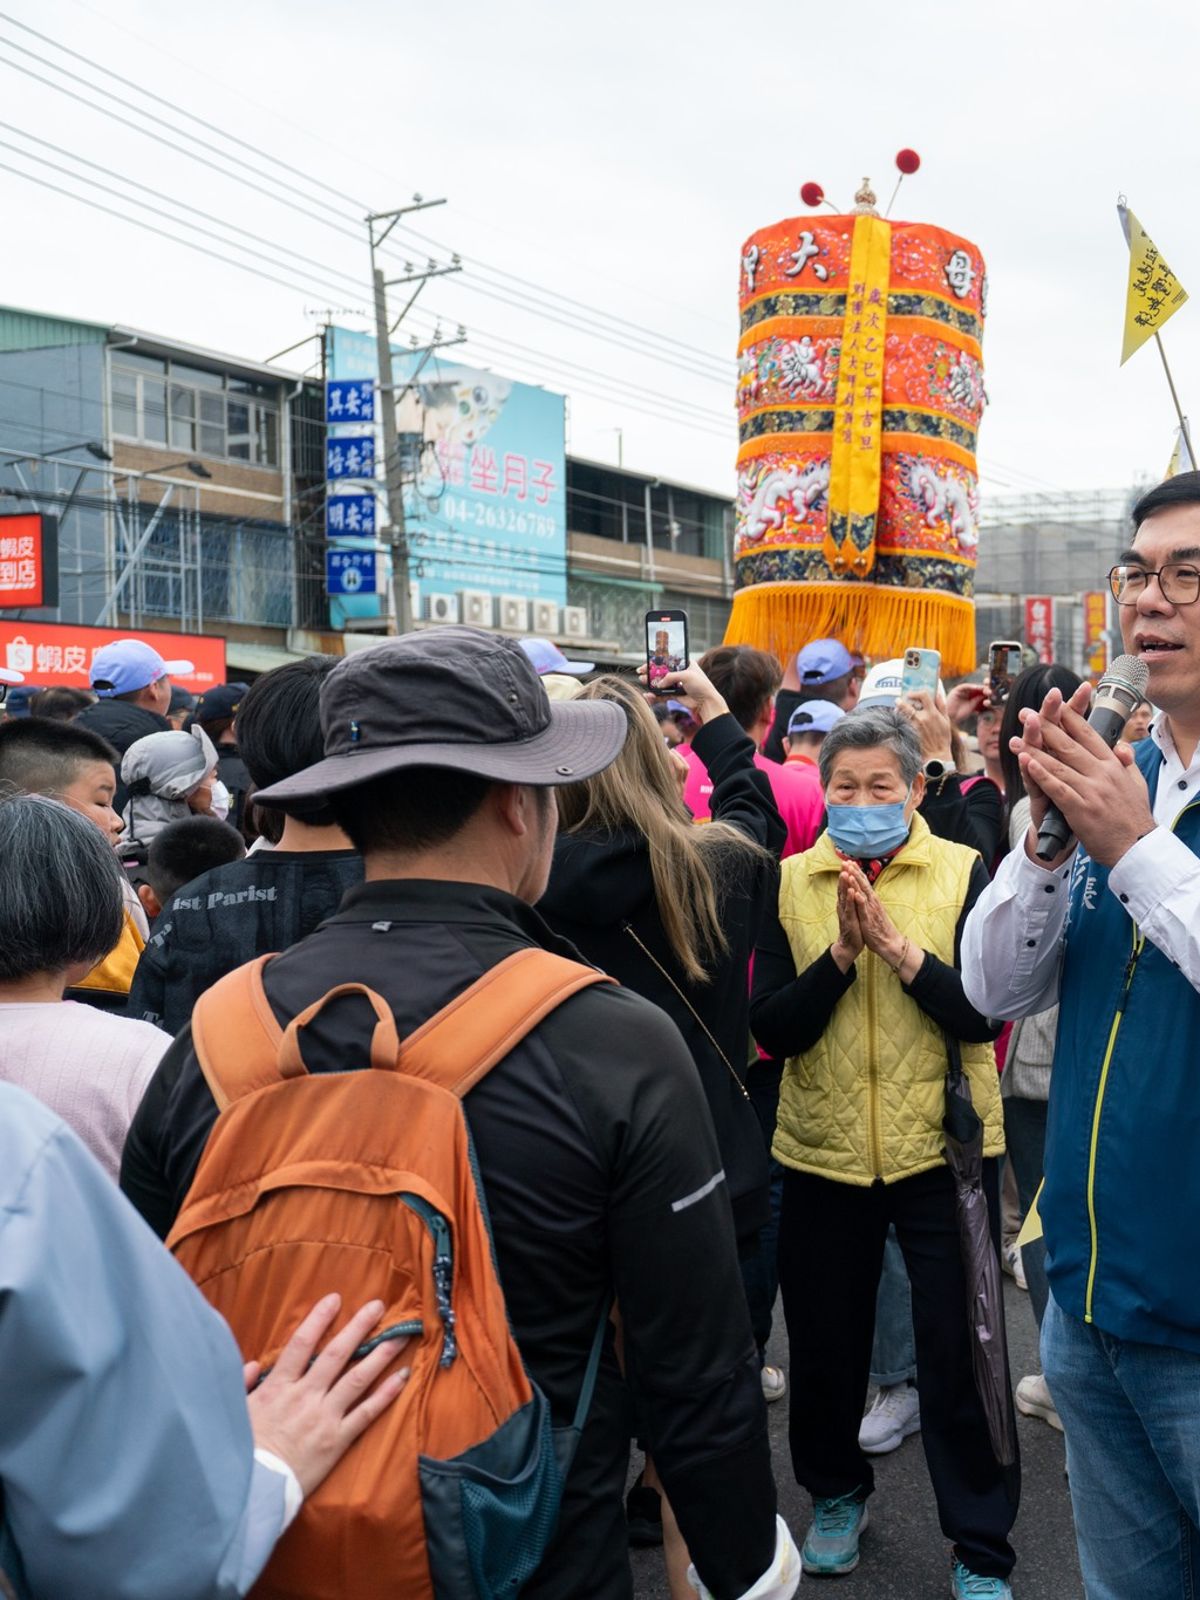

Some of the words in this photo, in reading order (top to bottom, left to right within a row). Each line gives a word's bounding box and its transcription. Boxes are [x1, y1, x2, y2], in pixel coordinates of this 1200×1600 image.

[471, 446, 557, 504] 坐月子
[36, 645, 101, 674] 蝦皮
[207, 885, 278, 909] Parist
